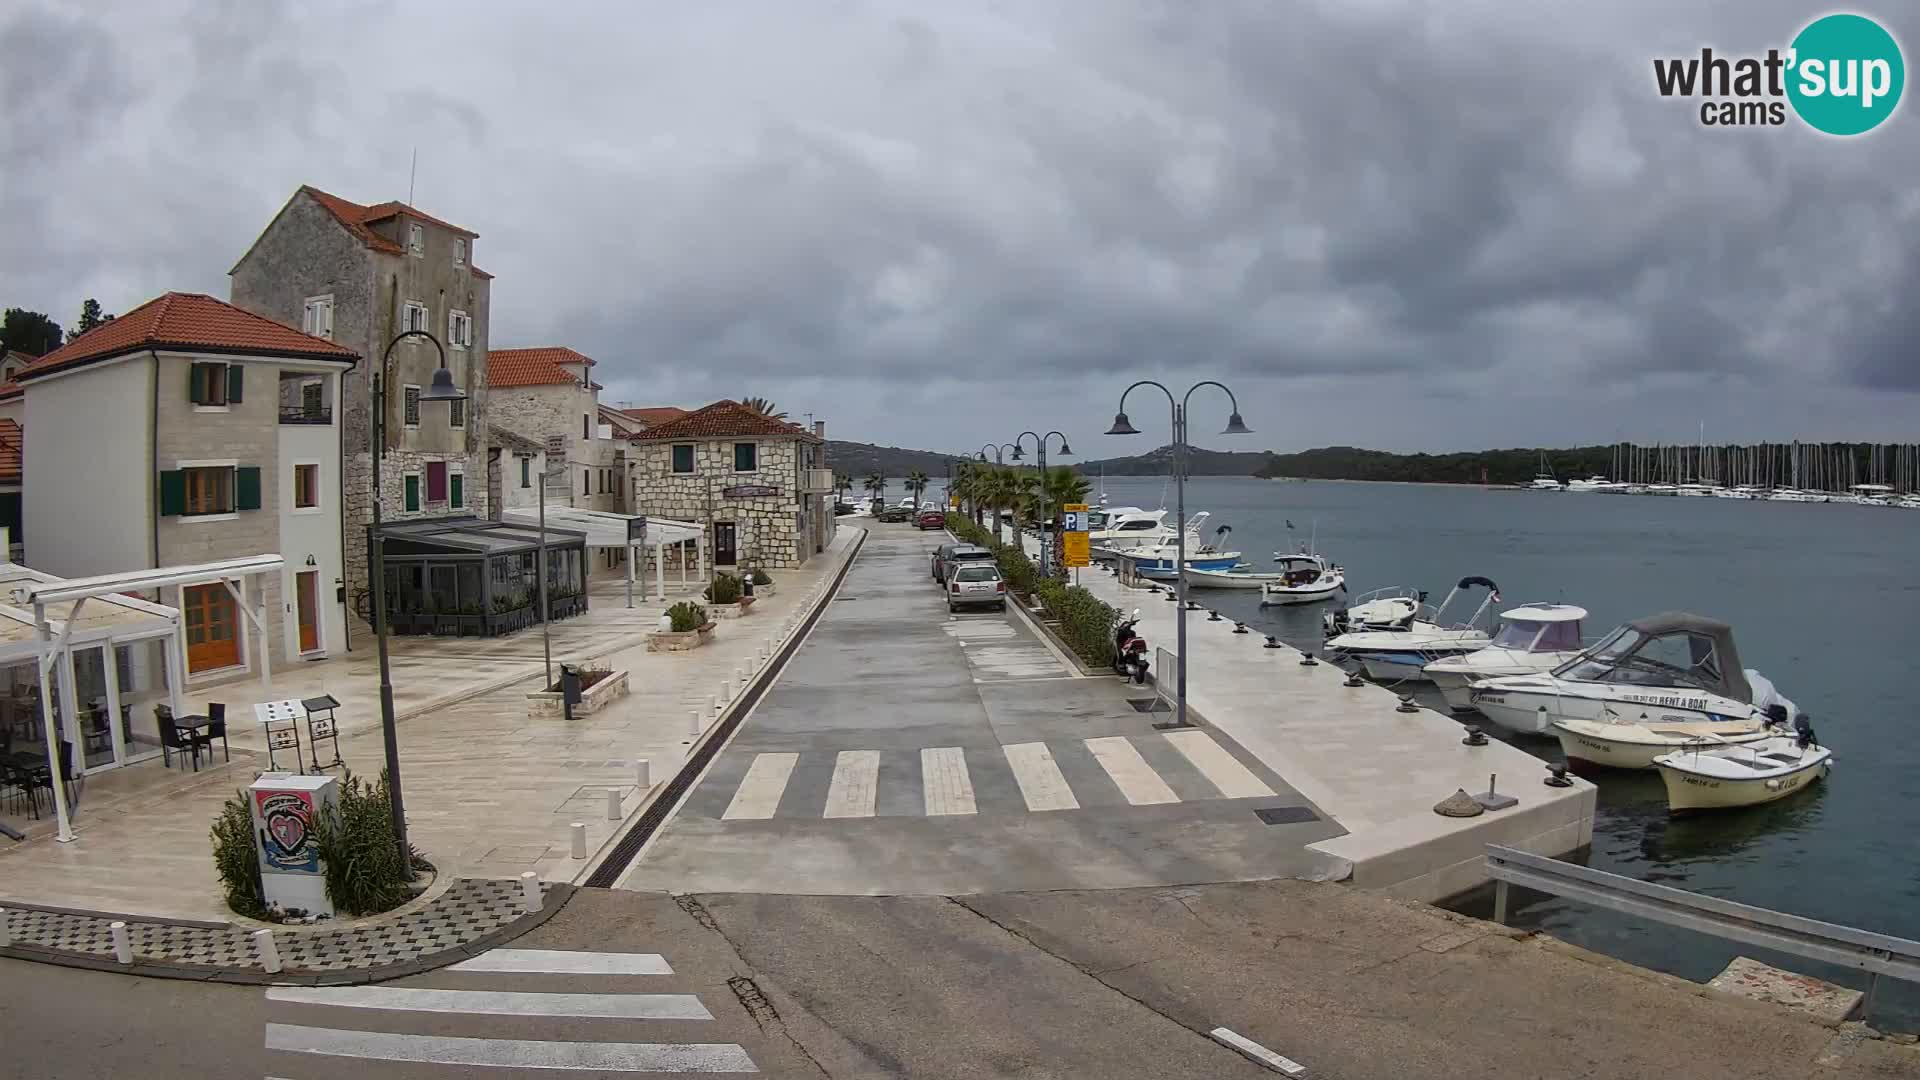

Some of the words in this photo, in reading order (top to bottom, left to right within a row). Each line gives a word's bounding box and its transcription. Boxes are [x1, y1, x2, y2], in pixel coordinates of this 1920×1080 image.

[1065, 513, 1076, 530] P
[1660, 696, 1680, 707] RENT
[1681, 697, 1687, 707] A
[1688, 698, 1708, 710] BOAT
